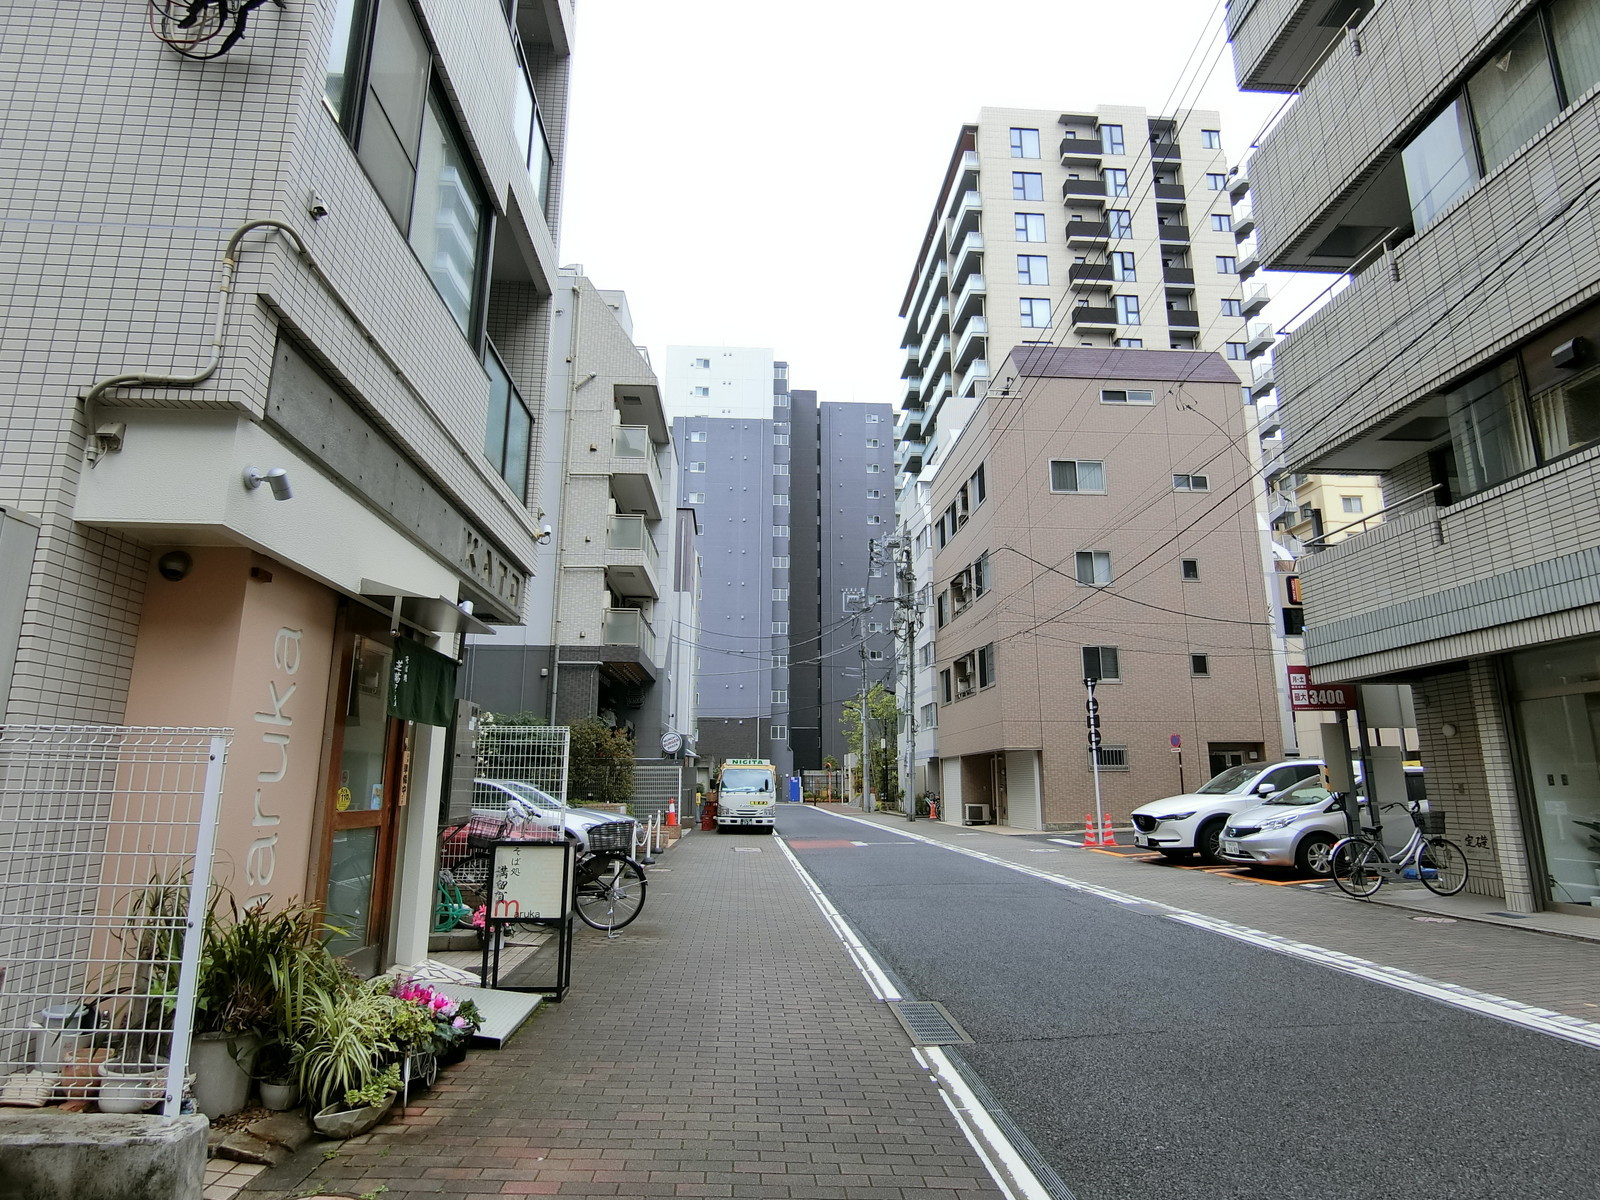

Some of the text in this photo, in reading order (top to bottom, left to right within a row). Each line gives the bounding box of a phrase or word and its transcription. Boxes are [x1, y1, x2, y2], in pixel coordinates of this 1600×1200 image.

[239, 626, 303, 924] aruka
[510, 847, 521, 877] そば処
[494, 900, 541, 918] maruka
